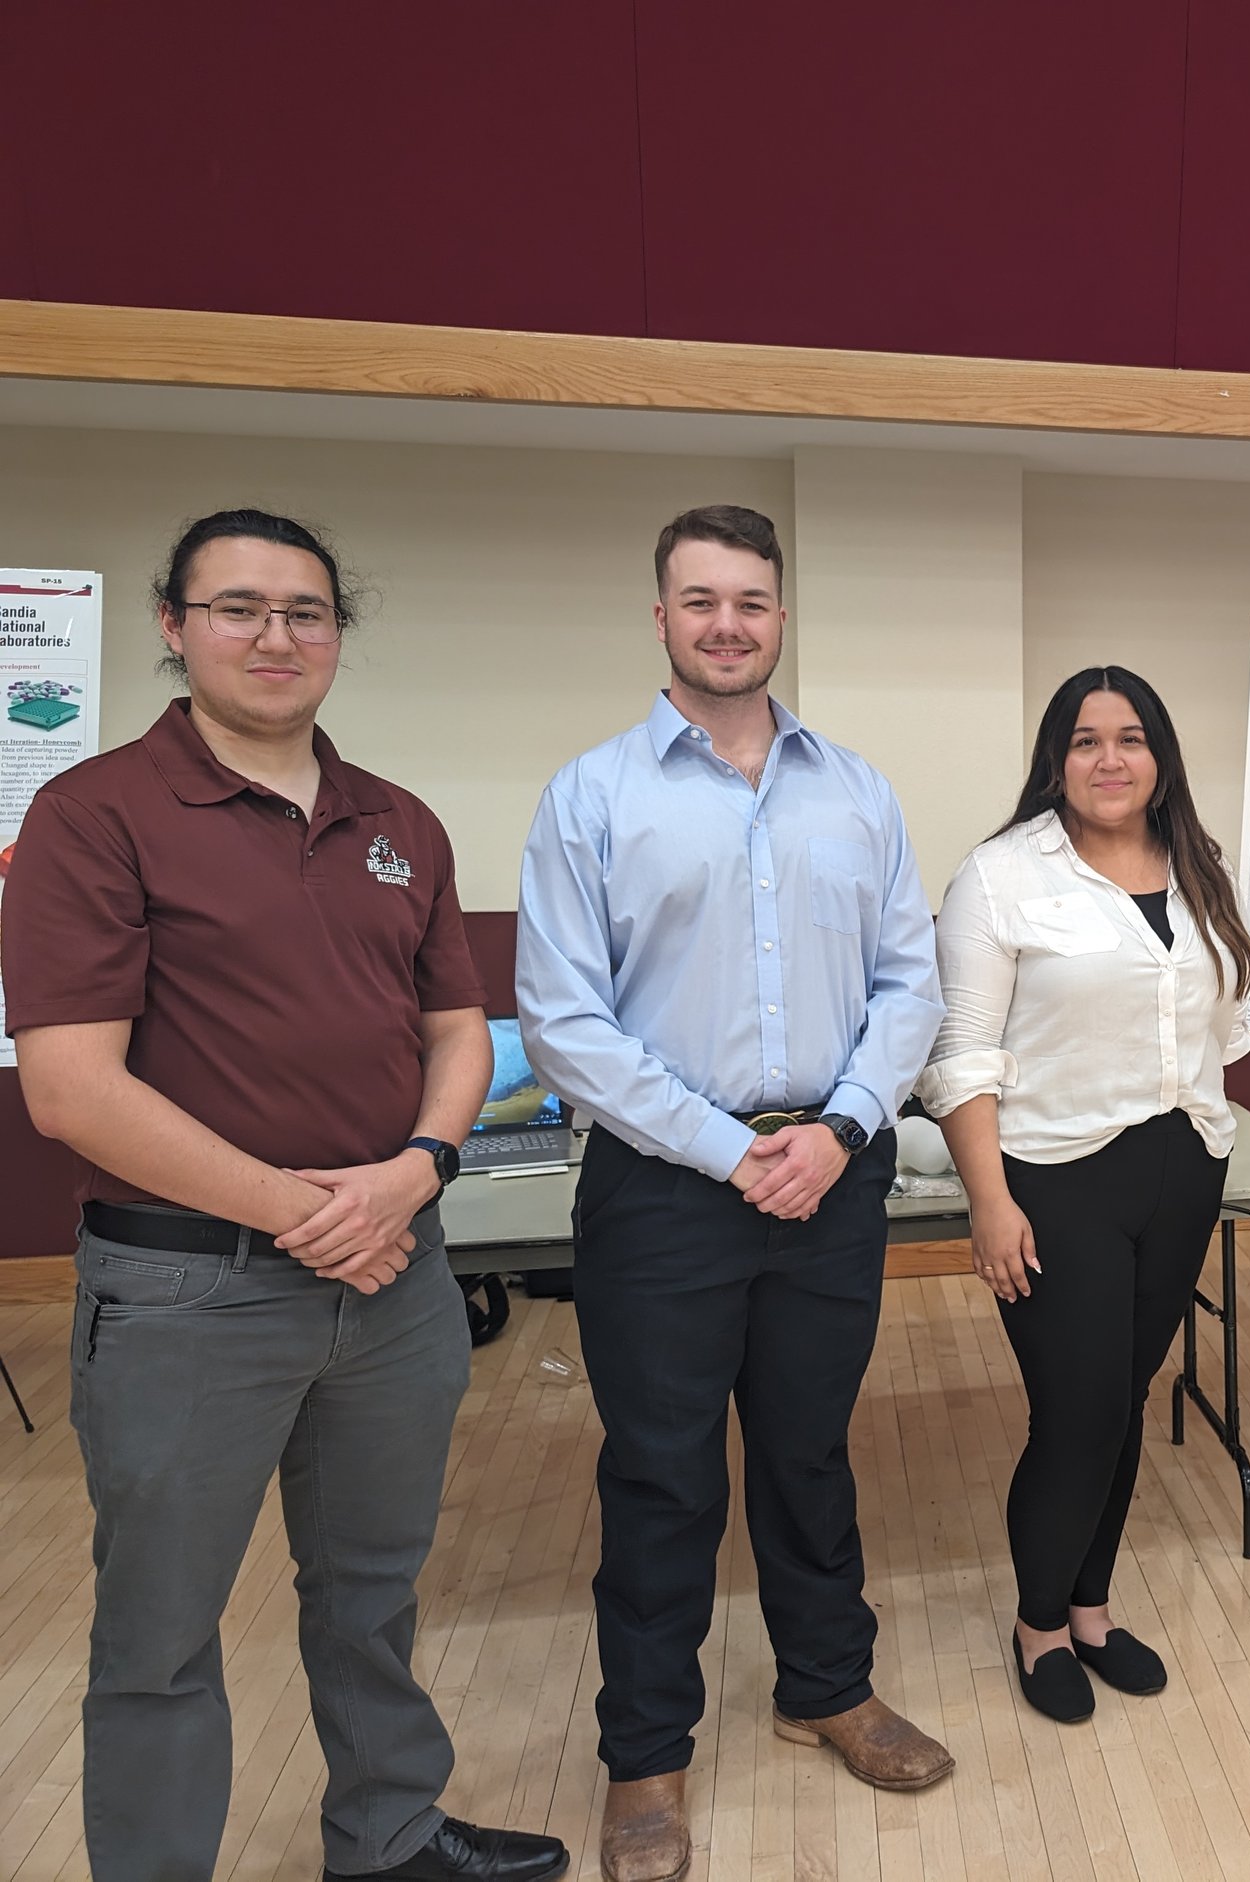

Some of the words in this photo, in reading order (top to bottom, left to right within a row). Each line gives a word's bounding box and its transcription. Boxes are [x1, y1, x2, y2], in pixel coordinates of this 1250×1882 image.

[0, 606, 36, 618] andia
[0, 635, 71, 647] aboratories
[376, 873, 409, 886] AGGIES
